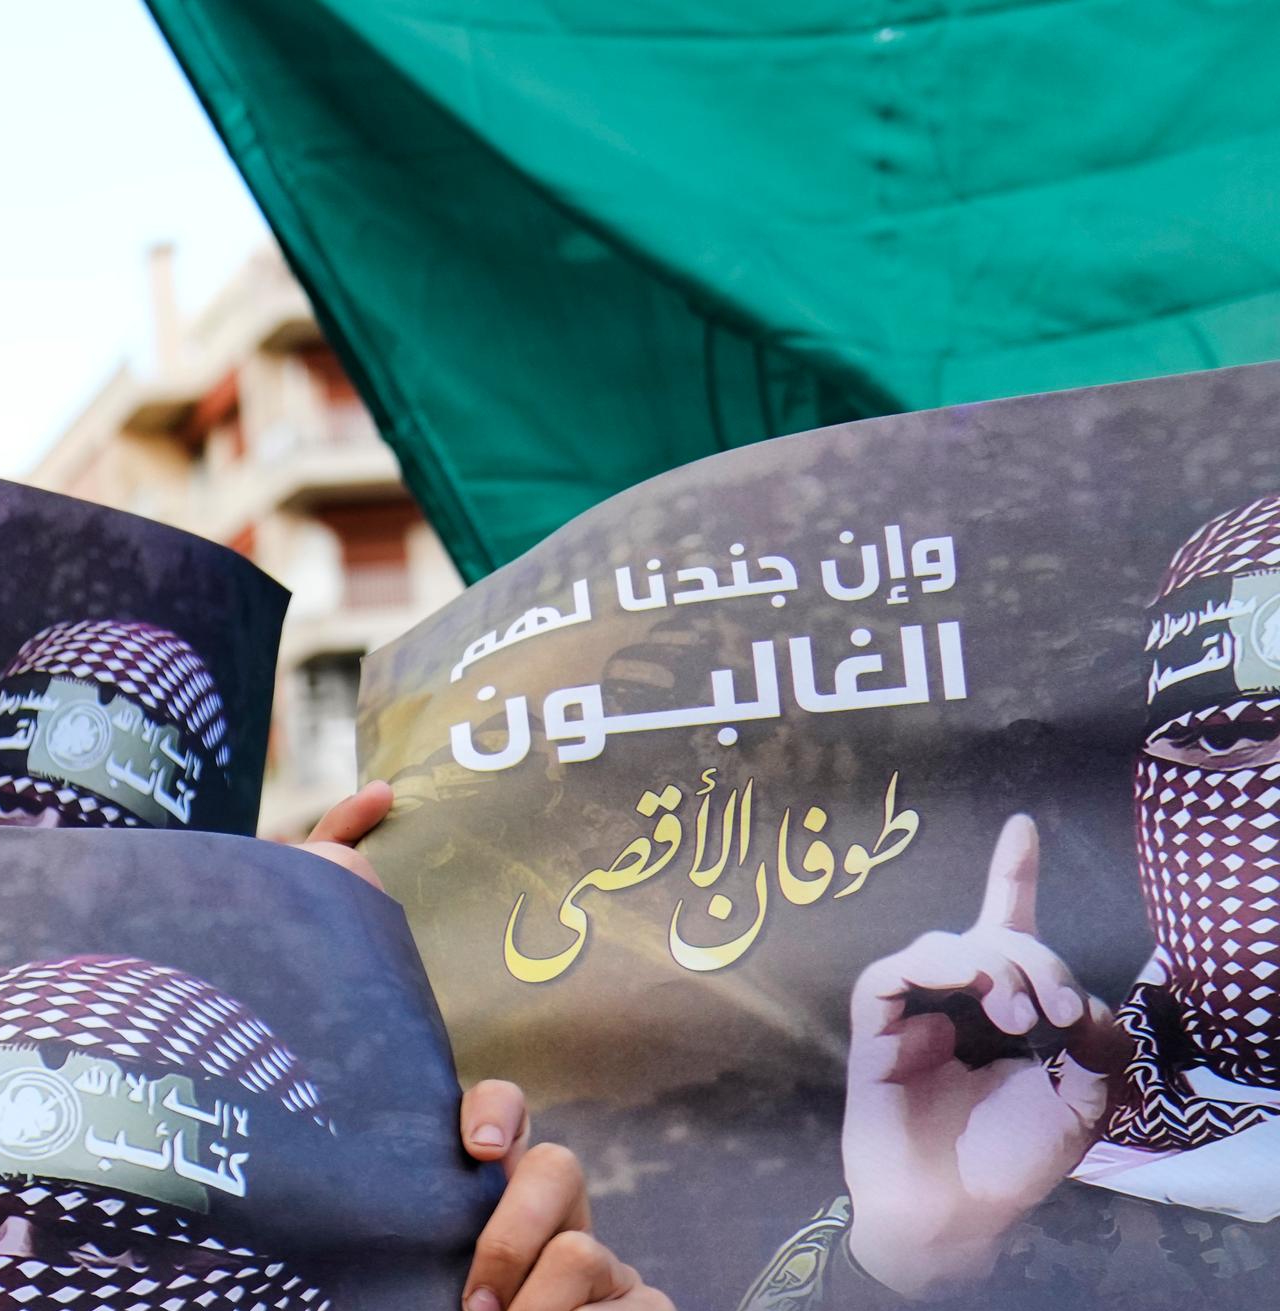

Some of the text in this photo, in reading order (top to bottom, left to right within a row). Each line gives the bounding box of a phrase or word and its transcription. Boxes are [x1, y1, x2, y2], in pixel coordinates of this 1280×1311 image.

[448, 525, 956, 685] وإن جندنا لهم
[502, 766, 920, 983] طوفان الأقصى
